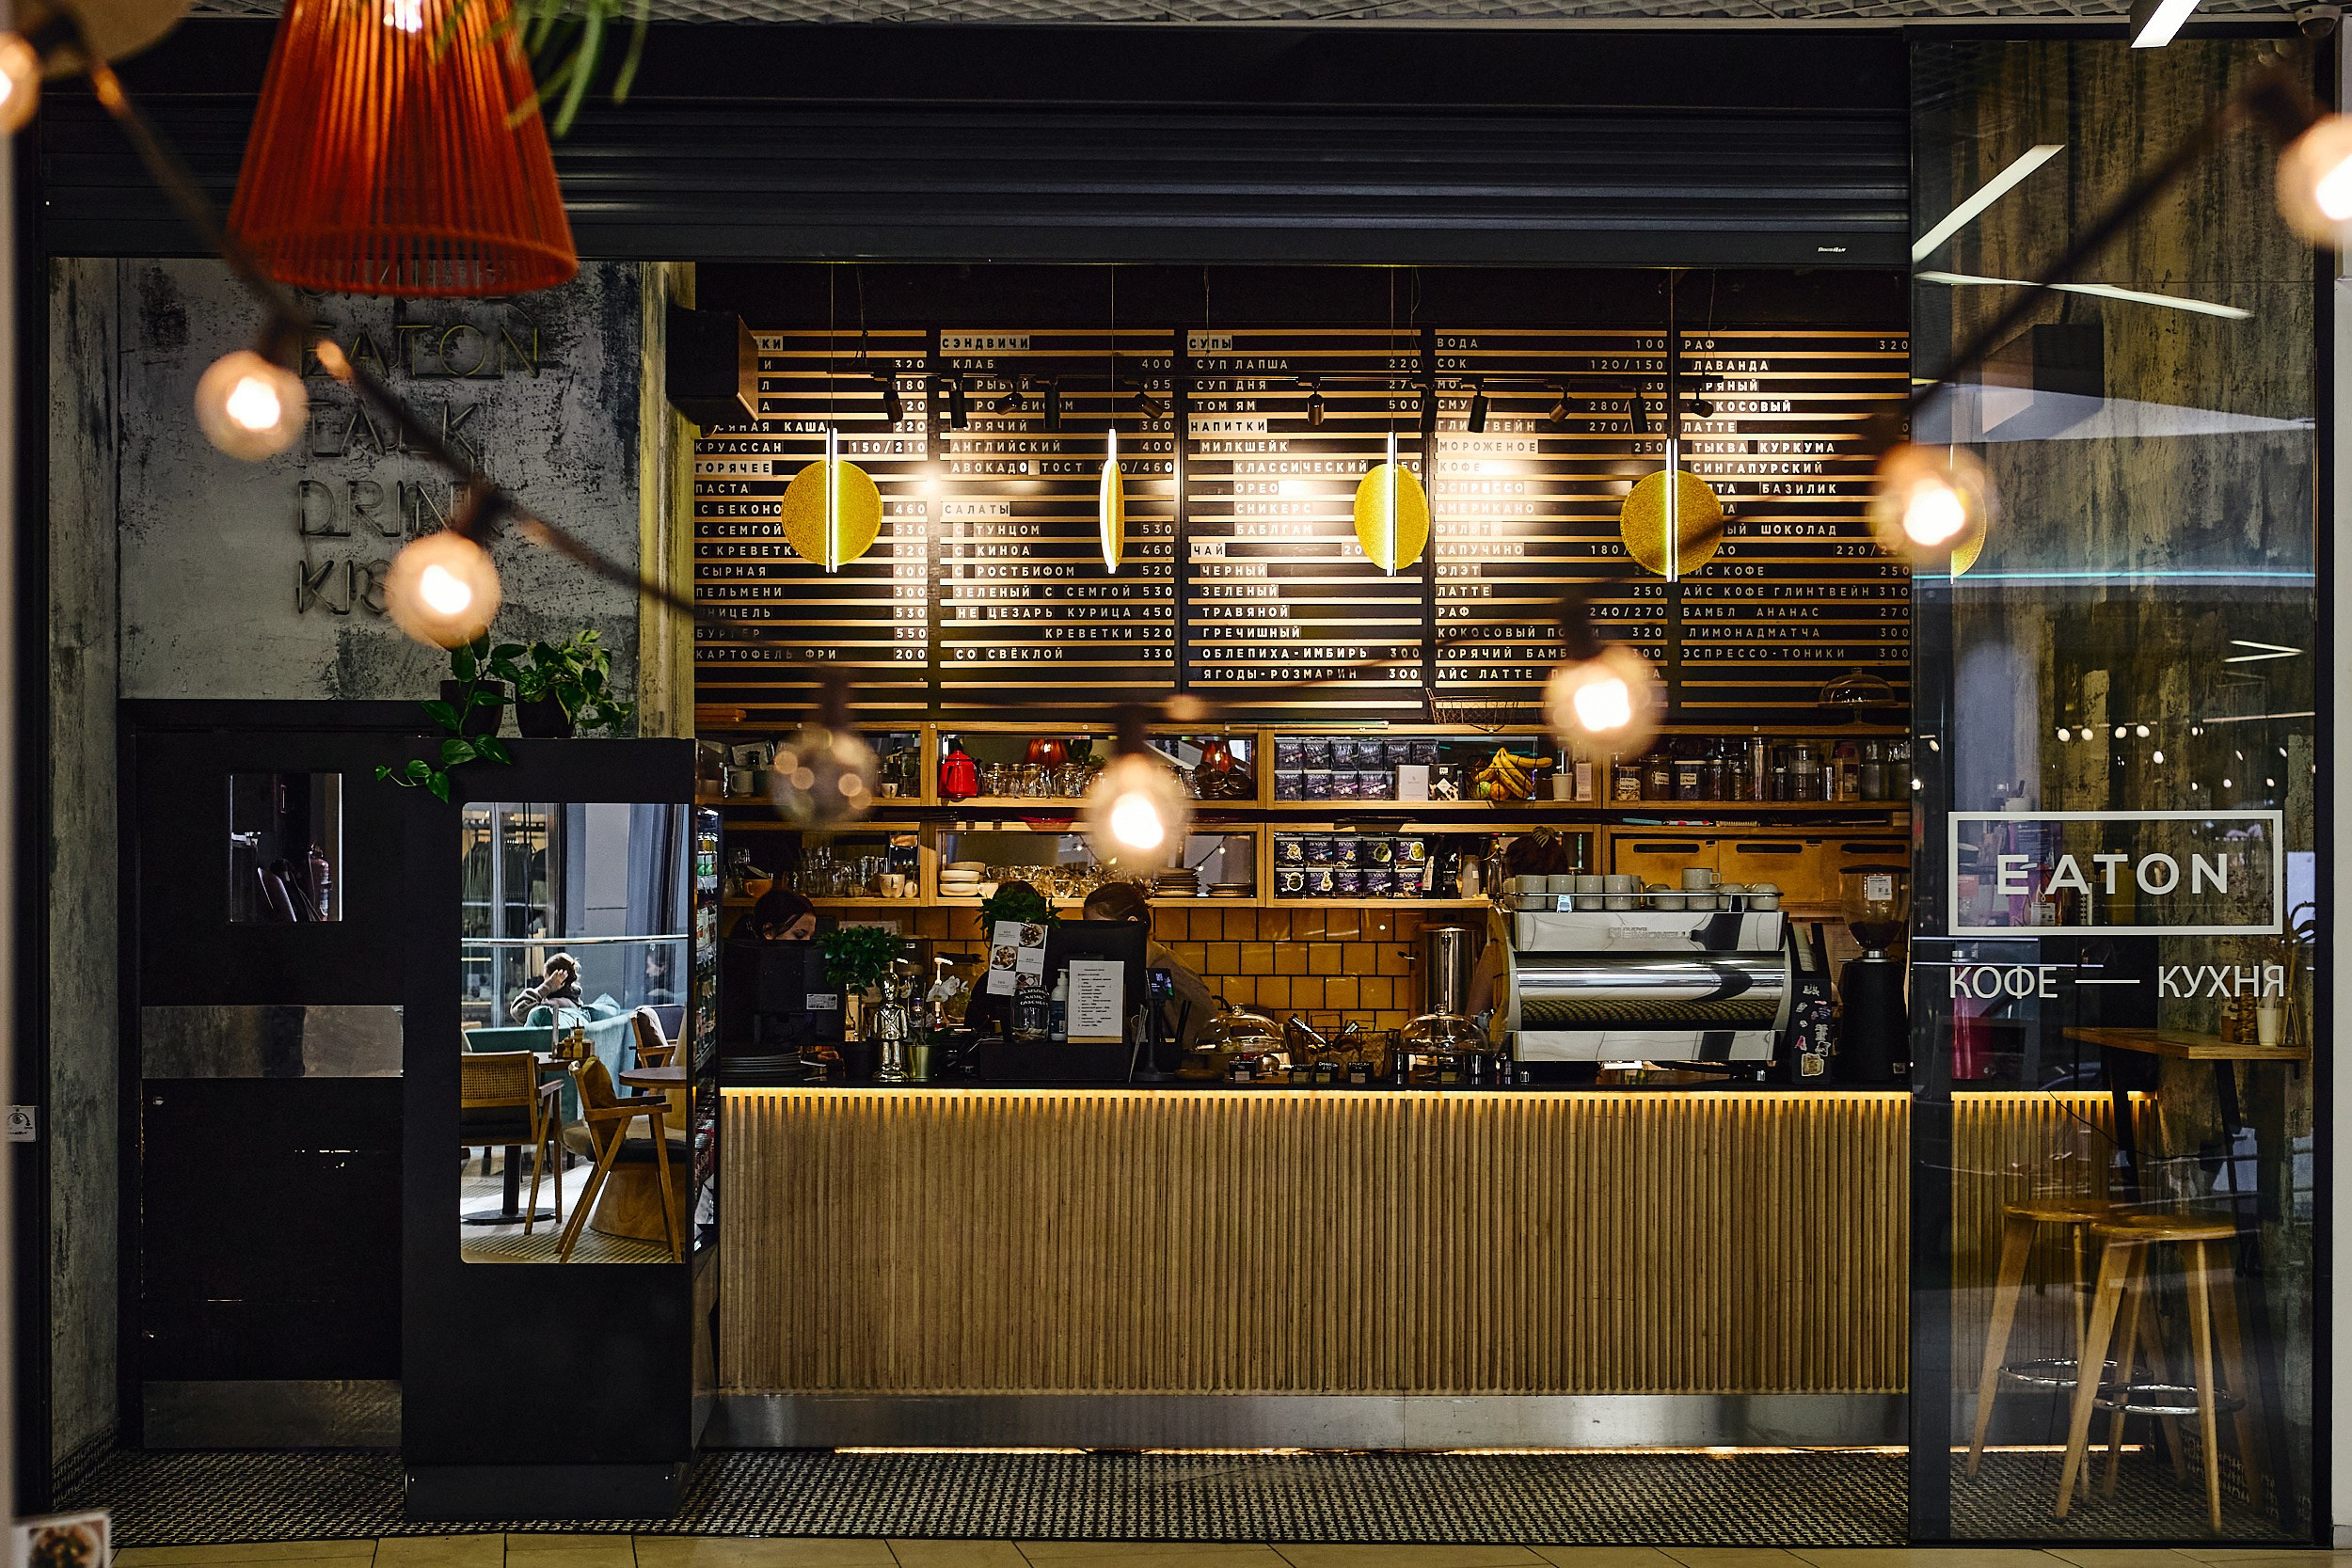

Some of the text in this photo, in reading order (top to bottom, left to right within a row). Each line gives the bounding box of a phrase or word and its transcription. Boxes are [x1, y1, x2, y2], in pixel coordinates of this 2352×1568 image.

[942, 339, 1028, 349] СЭНДВИЧИ
[1189, 339, 1232, 349] СУПЫ
[1438, 339, 1664, 349] ВОДА 100
[1685, 340, 1908, 350] РАФ 320
[300, 323, 539, 378] EATON
[895, 359, 925, 369] 320
[953, 359, 1170, 369] КЛАБ 400
[1197, 359, 1418, 370] СУП ЛАПША 220
[1438, 359, 1663, 370] СОК 120/150
[1693, 360, 1768, 372] ЛАВАНДА
[896, 381, 925, 390] 180
[977, 379, 1029, 389] РЫБЙ
[1197, 381, 1226, 390] СУП
[1236, 380, 1266, 391] ДНЯ
[1706, 379, 1757, 391] РЯНЫЙ
[901, 402, 925, 411] 20
[977, 401, 1073, 410] РОБИМ
[1197, 400, 1418, 411] ТОМ ЯМ 500
[1590, 402, 1663, 411] 280/20
[1708, 399, 1791, 412] КОСОВЫЙ
[785, 421, 925, 432] КАША 220
[953, 420, 1171, 431] ОРЯЧИЙ 360
[1191, 421, 1264, 431] НАПИТКИ
[1438, 420, 1534, 431] ГЛИТВЕЙН
[1683, 421, 1735, 432] ЛАТТЕ
[696, 442, 925, 452] КРУАССАН 150/210
[952, 440, 1171, 451] АНГЛИЙСКИЙ 400
[1201, 439, 1288, 451] МИЛКШЕЙК
[1439, 441, 1662, 451] МОРОЖЕНОЕ 250
[1695, 442, 1835, 452] ТЫКВА КУРКУМА
[695, 463, 770, 473] ГОРЯЧЕЕ
[952, 462, 1082, 474] АВОКАДО ТОСТ
[1235, 461, 1367, 472] КЛАССИЧЕСКИЙ
[1439, 462, 1480, 472] КОФЕ
[1693, 461, 1822, 473] СИНГАПУРСКИЙ
[696, 483, 748, 493] ПАСТА
[1235, 483, 1279, 493] ОРЕО
[1762, 483, 1836, 494] БАЗИЛИК
[298, 481, 504, 537] DRIN
[702, 504, 925, 515] С БЕКОНО 460
[945, 503, 1009, 515] САЛАТЫ
[1236, 503, 1311, 514] СНИКЕРС
[1437, 503, 1534, 514] АМЕРИКАНО
[702, 522, 925, 535] С СЕМГОЙ 530
[977, 526, 1040, 537] ТУНЦОМ
[1142, 525, 1171, 534] 530
[1237, 525, 1312, 534] БАБЛГАМ
[1761, 525, 1836, 536] ШОКОЛАД
[702, 546, 925, 556] С КРЕВЕТК 520
[955, 546, 1171, 556] С КИНОА 460
[1194, 544, 1223, 555] ЧАЙ
[1437, 545, 1523, 555] КАПУЧИНО
[703, 566, 925, 576] СЫРНАЯ 400
[955, 566, 1171, 577] С РОСТБИФОМ 520
[1202, 563, 1265, 576] ЧЕРНЫЙ
[1438, 565, 1479, 576] ФЛЭТ
[1724, 566, 1910, 576] КОФЕ 250
[696, 587, 925, 597] ПЕЛЬМЕНИ 300
[956, 584, 1172, 597] ЗЕЛЕНЫЙ С СЕМГОЙ 530
[1202, 584, 1277, 596] ЗЕЛЕНЫЙ
[1438, 587, 1662, 597] ЛАТТЕ 250
[1684, 584, 1908, 596] АЙС КОФЕ ГЛИНТВЕЙН 310
[698, 609, 925, 619] НИЦЕЛЬ 530
[958, 608, 1172, 620] НЕ ЦЕЗАРЬ КУРИЦА 450
[1202, 605, 1288, 617] ТРАВЯНОЙ
[1438, 607, 1664, 617] РАФ 240/270
[1684, 608, 1908, 617] БАМБЛ АНАНАС 270
[696, 628, 926, 639] БУРЕР 550
[1045, 628, 1172, 639] КРЕВЕТКИ 520
[1203, 626, 1299, 638] ГРЕЧИШНЫЙ
[1438, 626, 1661, 638] КОКОСОВЫЙ 320
[1881, 628, 1908, 637] 300
[696, 649, 925, 659] КАРТОФЕЛЬ ФРИ 200
[956, 647, 1172, 659] СО СВЁКЛОЙ 330
[1391, 648, 1420, 658] 300
[1438, 647, 1661, 658] ГОРЯЧИЙ 300
[1880, 649, 1908, 657] 300
[1389, 670, 1418, 679] 300
[1438, 668, 1533, 679] АЙС ЛАТТЕ
[1997, 853, 2228, 895] EATON
[1950, 965, 2284, 999] КОФЕ КУХНЯ
